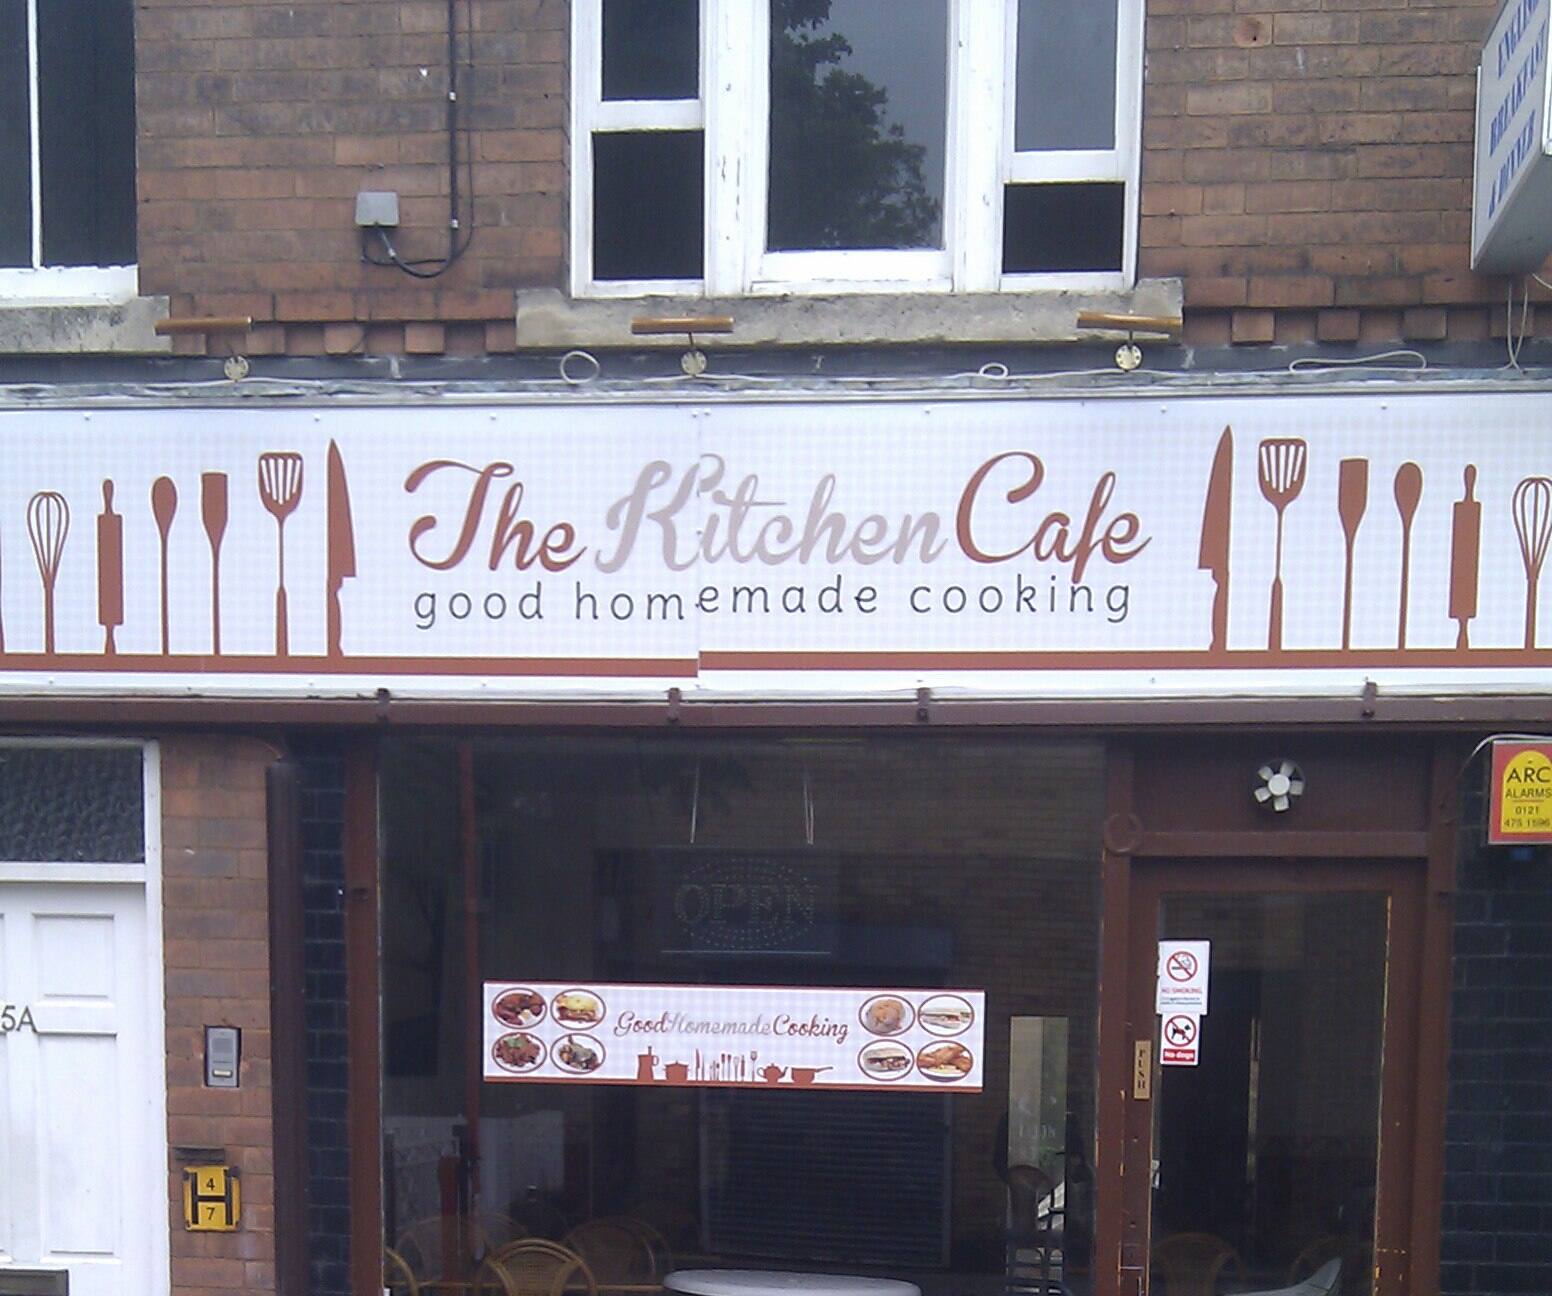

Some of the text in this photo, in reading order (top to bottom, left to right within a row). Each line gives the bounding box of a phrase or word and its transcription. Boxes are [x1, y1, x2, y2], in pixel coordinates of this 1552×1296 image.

[404, 451, 1153, 584] The Kitchen Cafe
[413, 573, 1130, 630] good homemade cooking
[1506, 766, 1552, 783] ARC
[1505, 788, 1552, 799] ALARMS
[1515, 806, 1539, 816] 0121
[675, 884, 819, 925] OPEN
[1, 1005, 38, 1032] 5A
[613, 1010, 849, 1044] Good Homemade Cooking
[206, 1177, 216, 1191] 4
[206, 1206, 216, 1221] 7
